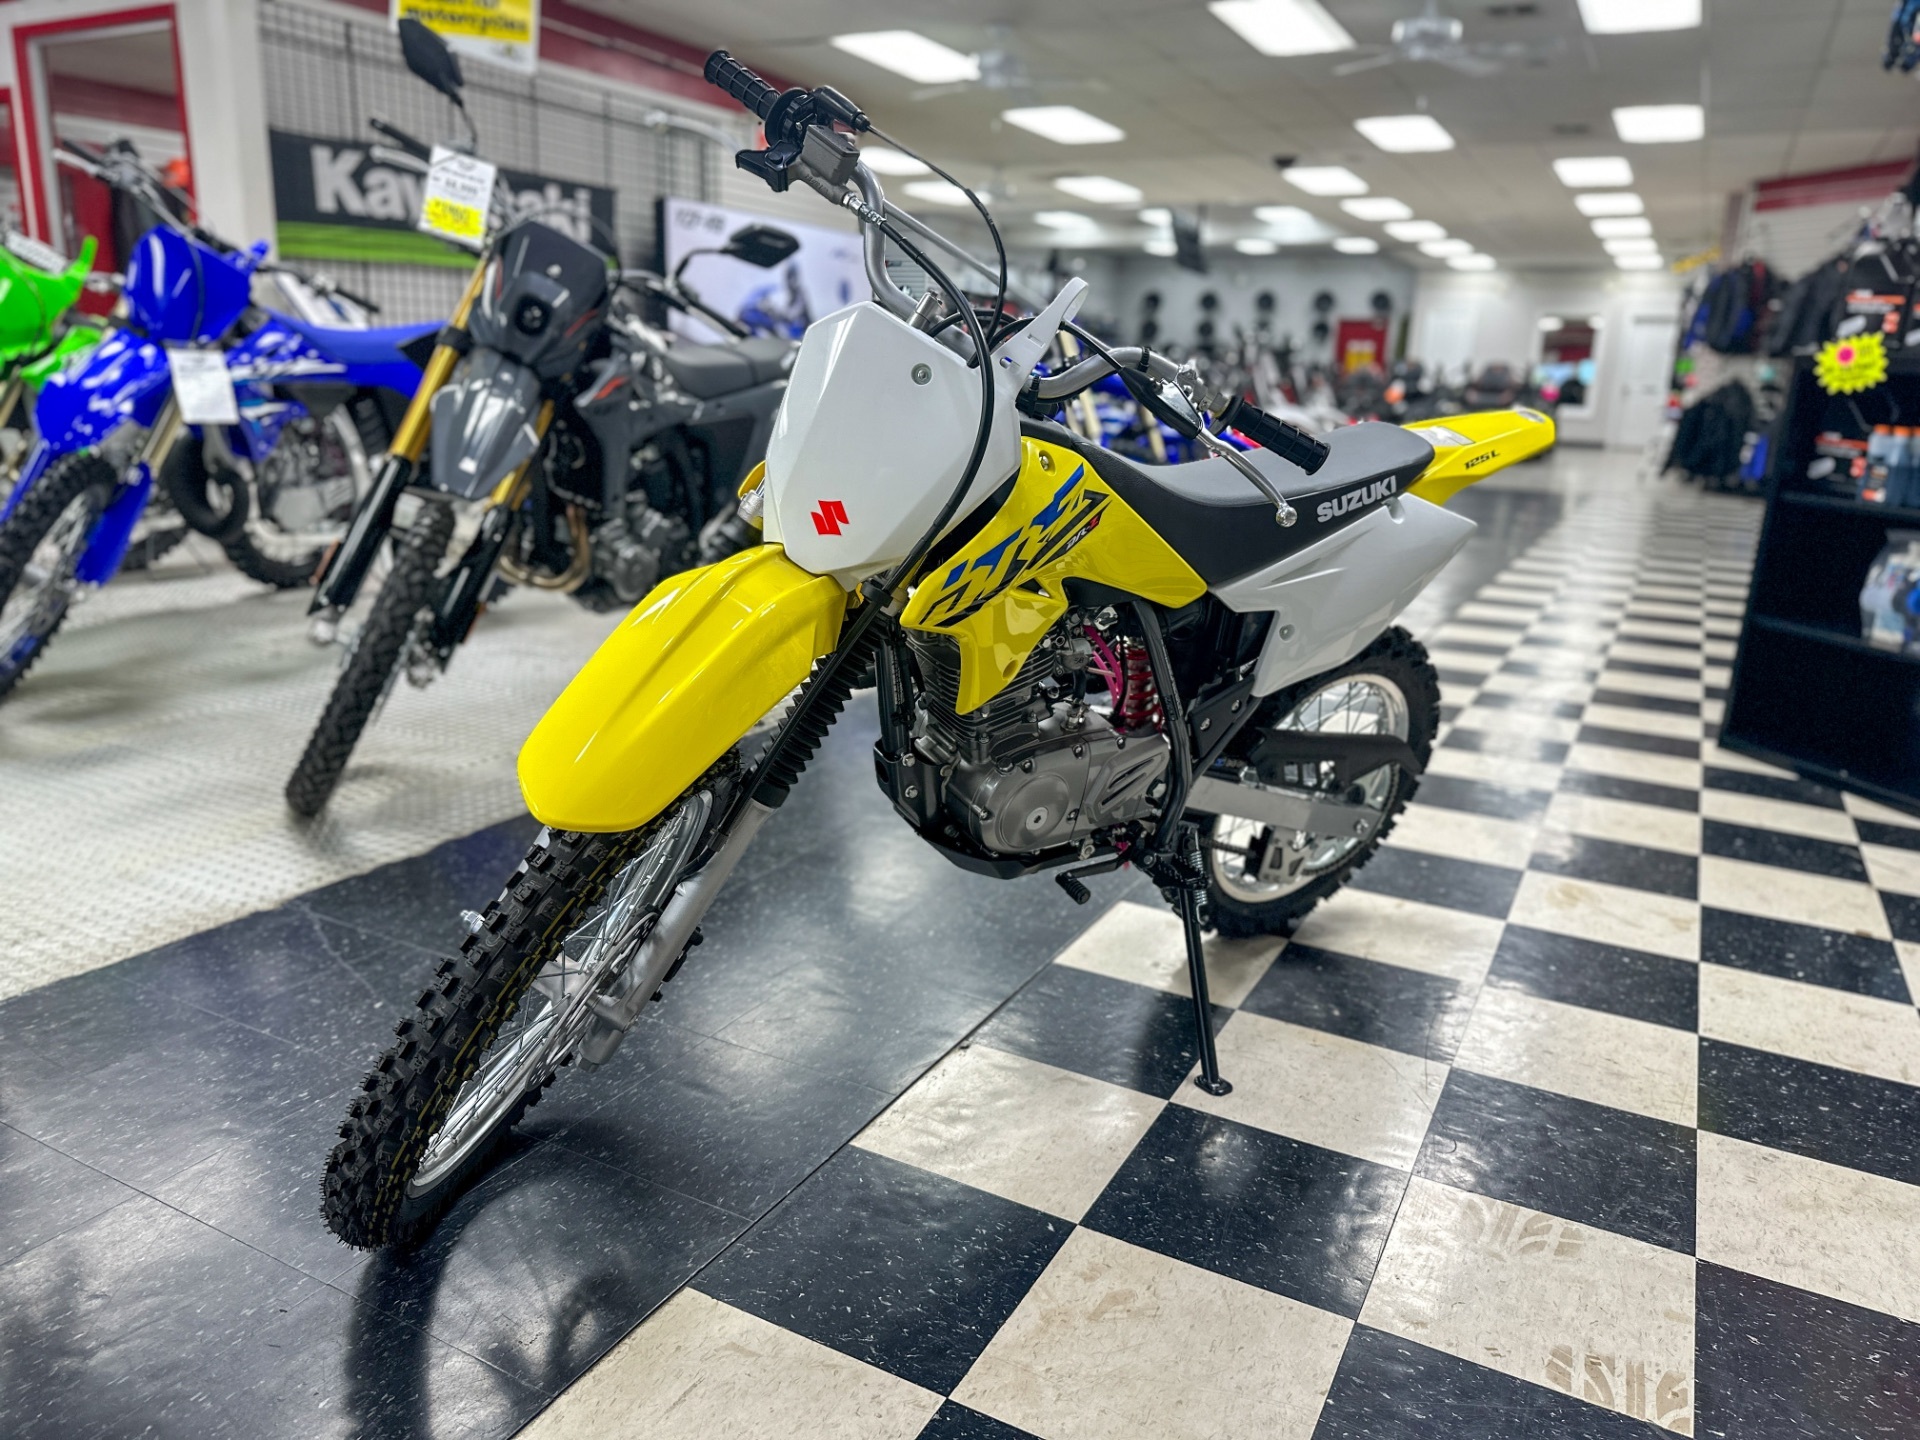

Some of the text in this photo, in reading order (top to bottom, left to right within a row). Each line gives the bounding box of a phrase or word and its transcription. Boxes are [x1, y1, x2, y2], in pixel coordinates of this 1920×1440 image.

[310, 144, 592, 243] Kaaki
[1464, 449, 1501, 470] 125L
[1316, 475, 1397, 523] SUZUKI
